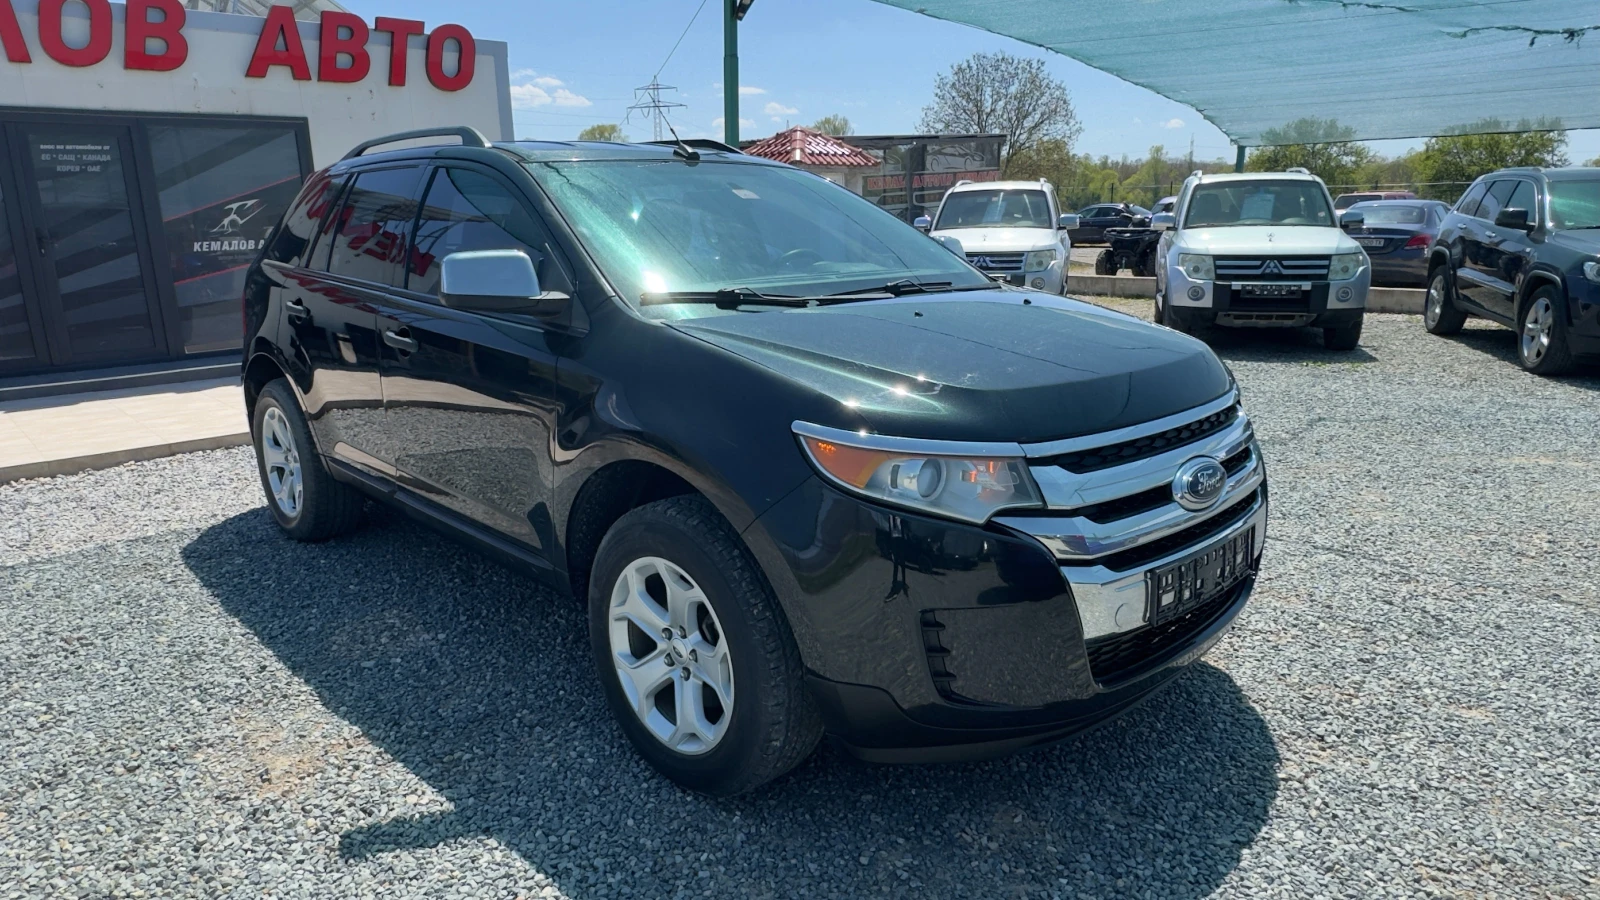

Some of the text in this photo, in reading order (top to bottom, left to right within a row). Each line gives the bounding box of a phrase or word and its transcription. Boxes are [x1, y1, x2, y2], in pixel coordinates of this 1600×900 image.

[245, 5, 476, 91] АВТО
[82, 154, 111, 162] КАНАДА
[193, 240, 255, 252] КЕМАЛОВ
[1197, 469, 1220, 494] Ford
